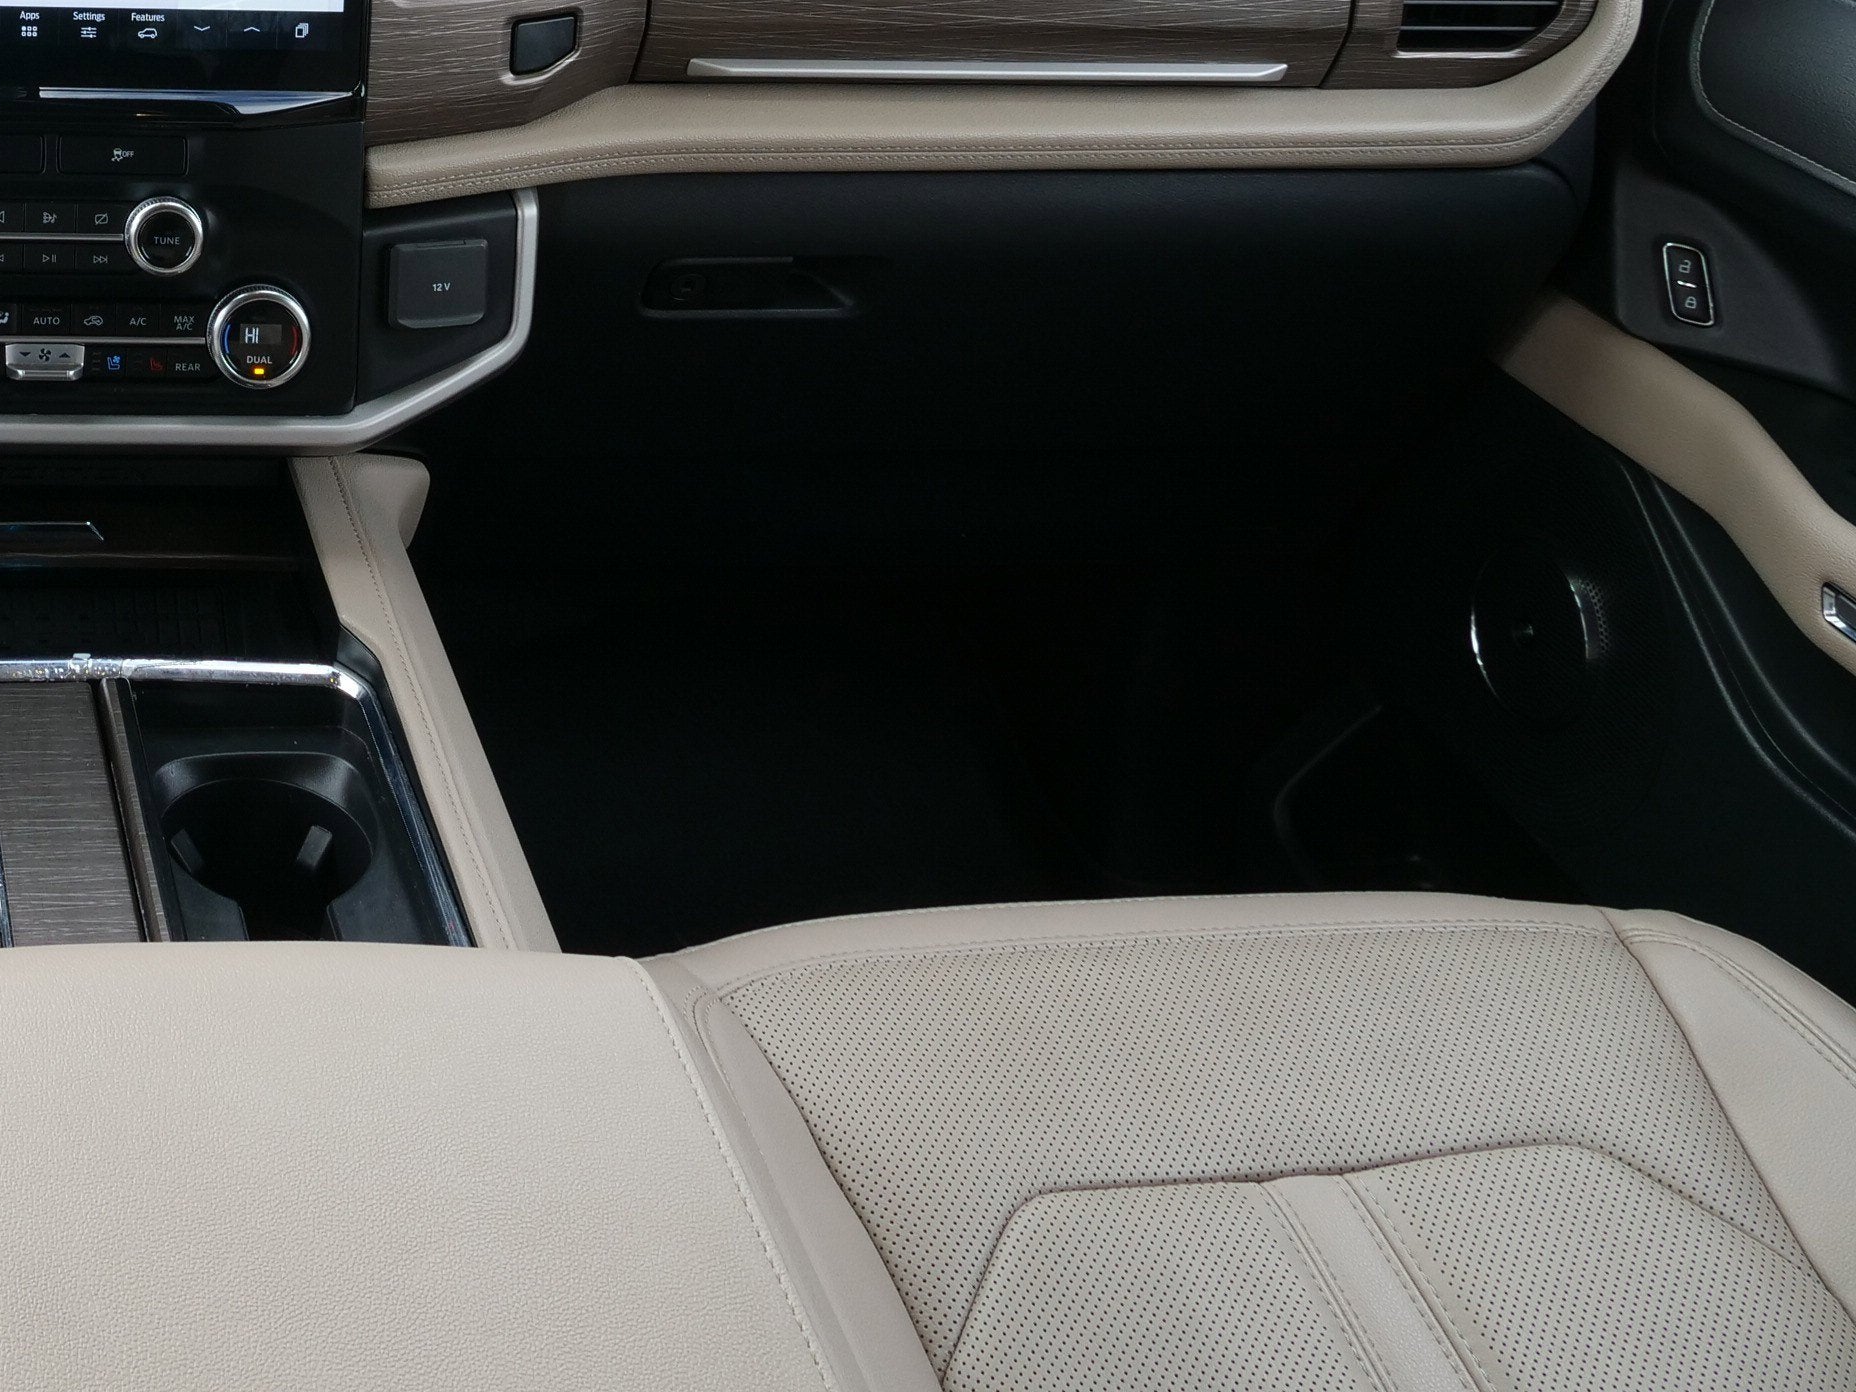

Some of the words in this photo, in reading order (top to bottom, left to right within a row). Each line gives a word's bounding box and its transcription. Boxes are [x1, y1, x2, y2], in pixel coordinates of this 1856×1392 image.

[19, 10, 40, 21] Apps
[73, 11, 106, 22] Settings
[131, 12, 165, 22] Features
[122, 150, 135, 158] OFF
[154, 236, 180, 246] TUNE
[33, 316, 60, 326] AUTO
[129, 316, 147, 328] A/C
[173, 315, 195, 324] MAX
[175, 323, 193, 332] A/C
[244, 326, 260, 345] HI
[246, 355, 273, 365] DUAL
[175, 363, 201, 372] REAR
